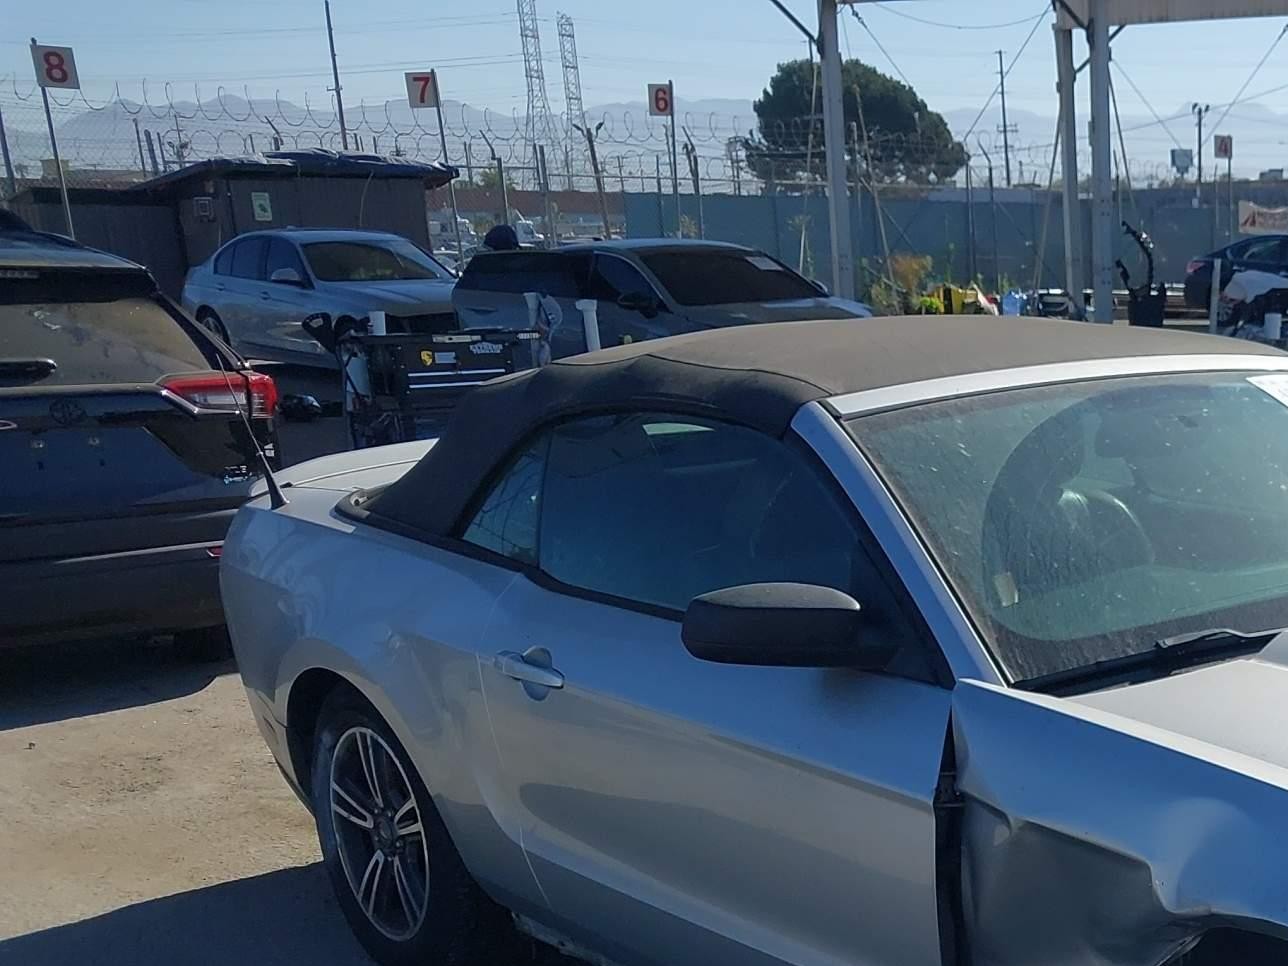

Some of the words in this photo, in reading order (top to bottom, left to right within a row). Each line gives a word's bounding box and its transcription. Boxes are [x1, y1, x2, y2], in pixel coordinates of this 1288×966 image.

[43, 51, 68, 83] 8
[412, 76, 431, 104] 7
[655, 87, 669, 112] 6
